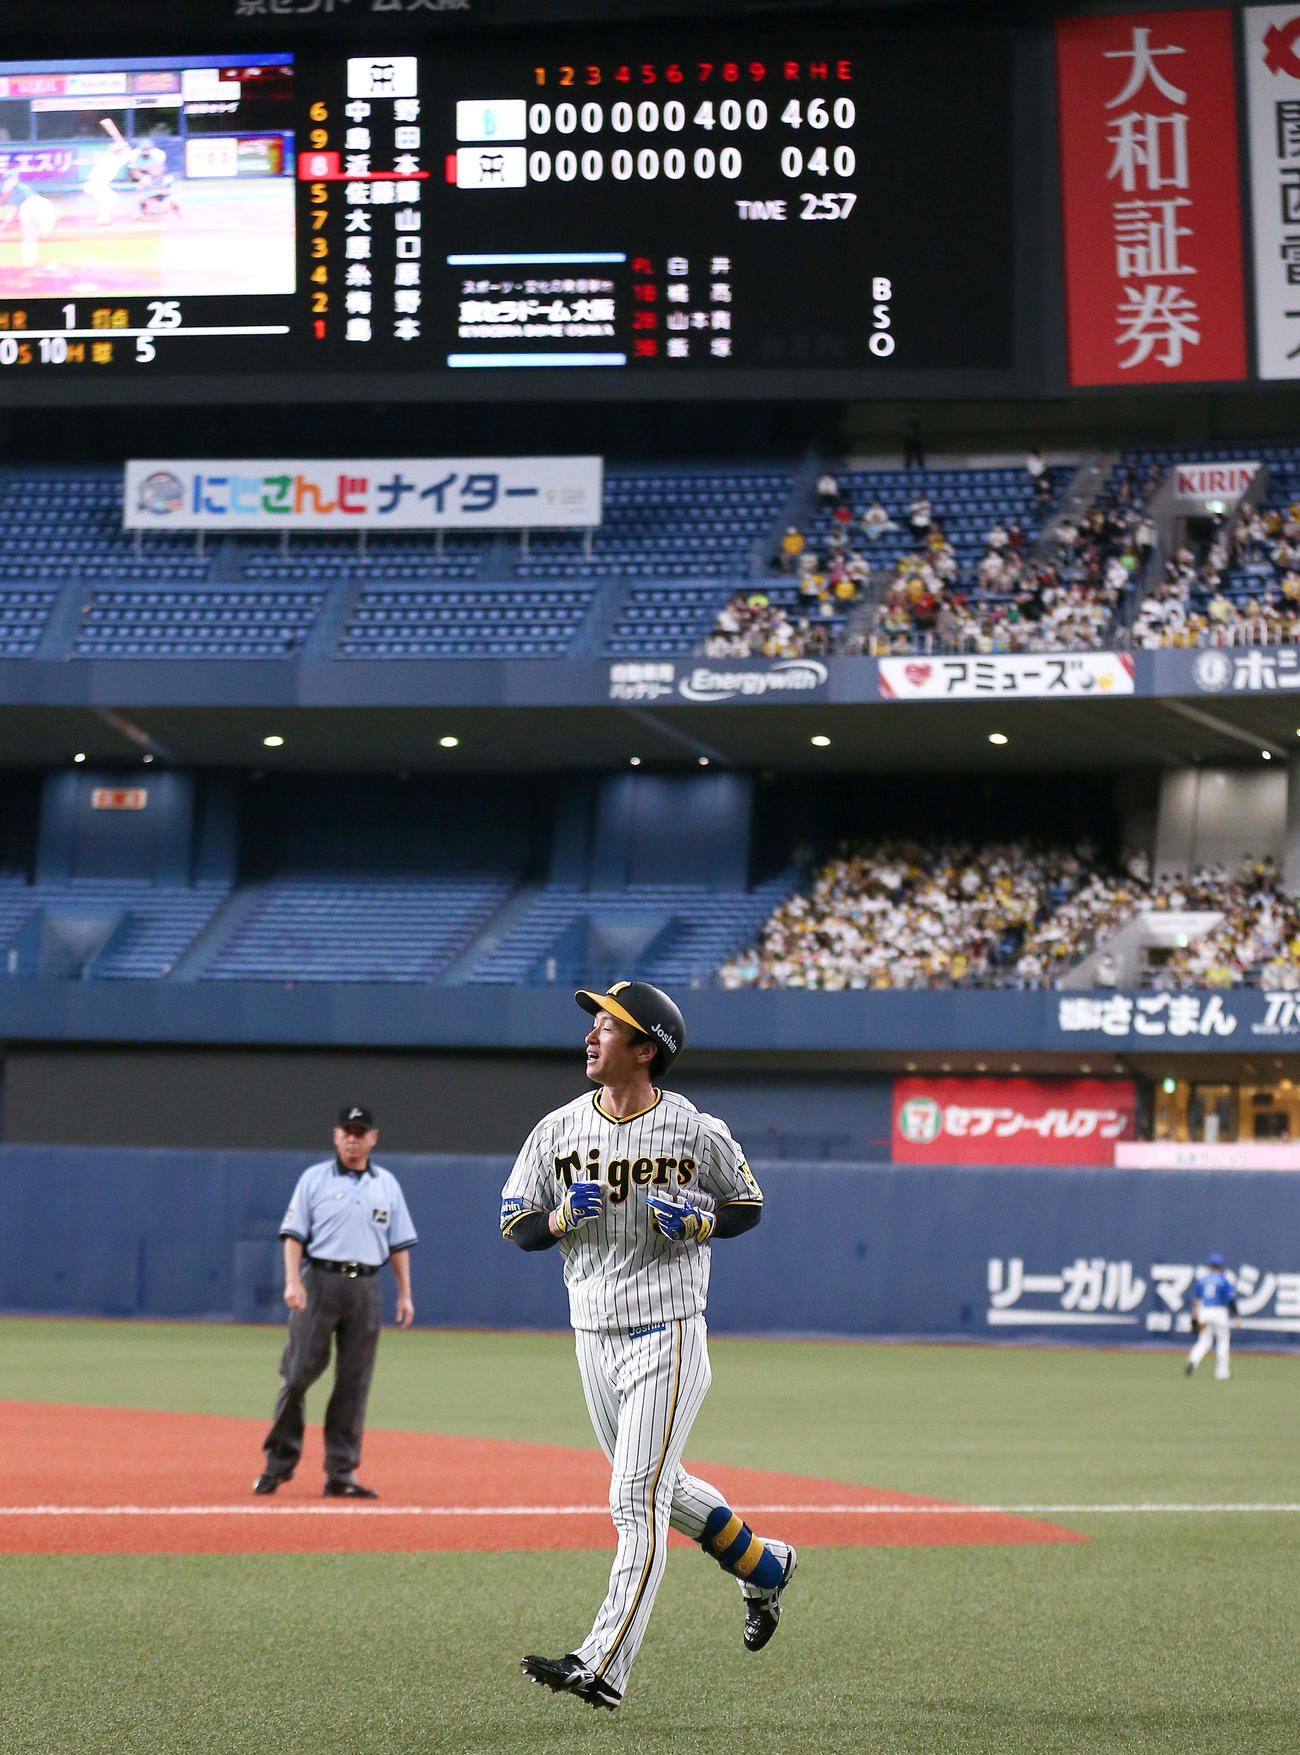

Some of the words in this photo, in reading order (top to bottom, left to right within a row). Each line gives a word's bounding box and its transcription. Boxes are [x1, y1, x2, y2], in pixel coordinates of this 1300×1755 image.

[534, 66, 546, 86] 1
[559, 66, 575, 86] 2
[585, 65, 601, 86] 3
[613, 65, 631, 83] 4
[641, 64, 657, 84] 5
[665, 64, 684, 83] 6
[698, 63, 713, 82] 7
[722, 62, 739, 82] 8
[749, 61, 766, 82] 9
[784, 61, 800, 80] R
[809, 62, 828, 80] H
[836, 60, 852, 80] E
[309, 101, 328, 121] 6
[309, 128, 328, 149] 9
[309, 155, 329, 176] 8
[310, 183, 328, 204] 5
[1103, 26, 1201, 370] 大和証券
[735, 200, 788, 221] TIME
[799, 193, 858, 220] 2:57
[310, 210, 328, 231] 7
[310, 237, 329, 258] 3
[309, 264, 328, 285] 4
[311, 291, 328, 312] 2
[872, 277, 892, 301] B
[62, 303, 76, 329] 1
[147, 301, 182, 329] 25
[872, 304, 891, 329] S
[311, 318, 326, 339] 1
[135, 336, 156, 363] 5
[868, 332, 895, 357] O
[1178, 468, 1256, 494] KIRIN
[942, 659, 1083, 692] アミューズ
[651, 1023, 677, 1054] Joshin
[554, 1148, 697, 1203] Tigers
